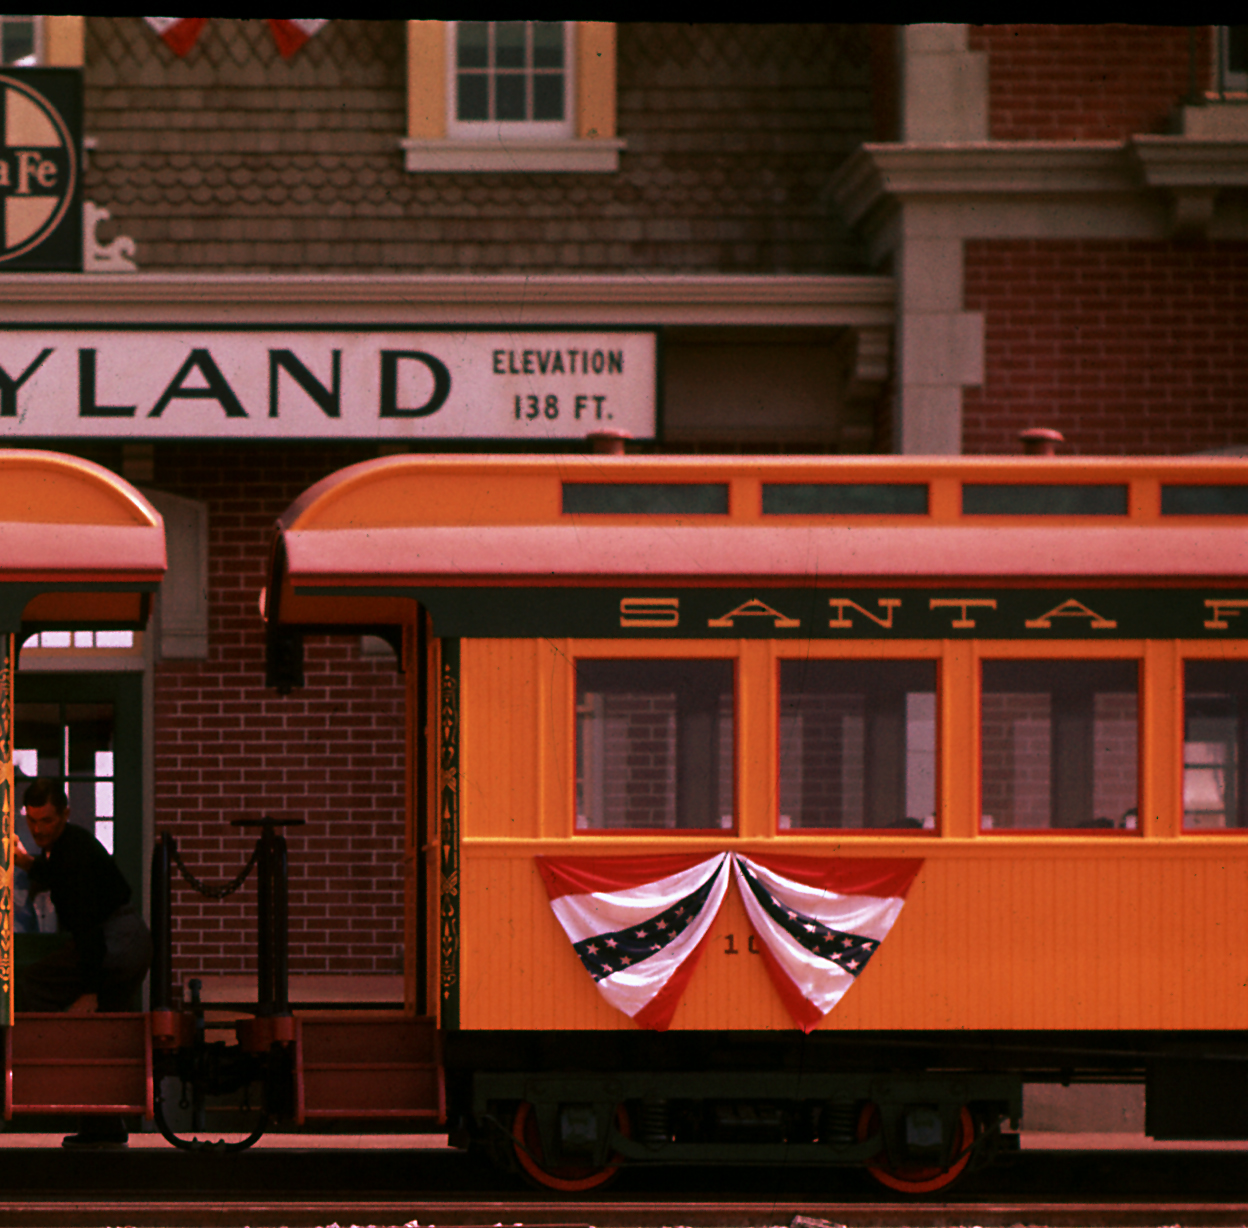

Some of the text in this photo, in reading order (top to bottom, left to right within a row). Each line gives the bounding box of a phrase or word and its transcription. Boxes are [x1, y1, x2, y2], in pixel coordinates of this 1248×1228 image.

[14, 150, 58, 194] Fe
[492, 349, 624, 375] ELEVATION
[514, 394, 614, 420] 138 FT.
[619, 597, 1118, 630] SANTA
